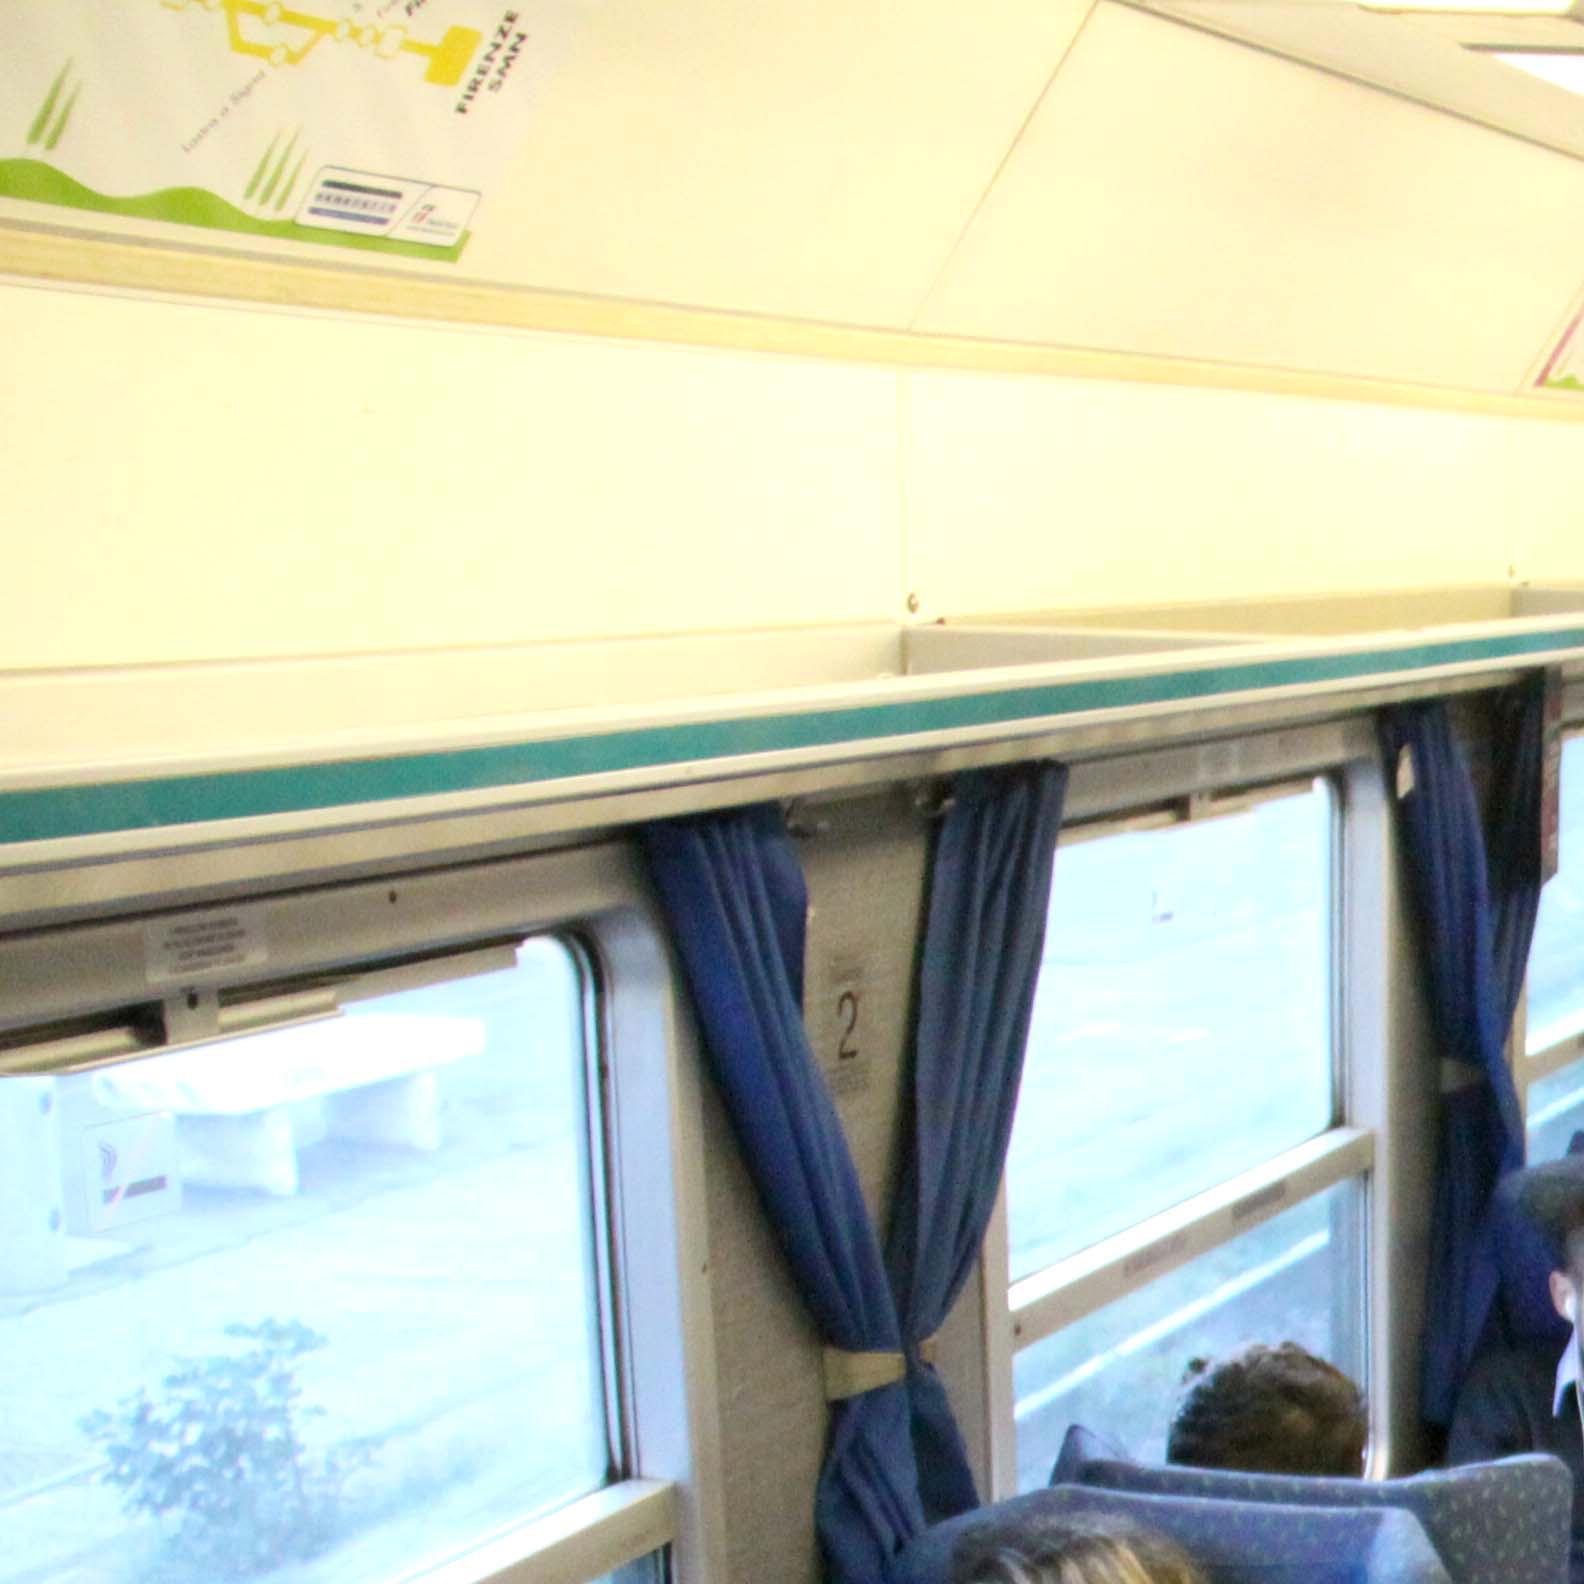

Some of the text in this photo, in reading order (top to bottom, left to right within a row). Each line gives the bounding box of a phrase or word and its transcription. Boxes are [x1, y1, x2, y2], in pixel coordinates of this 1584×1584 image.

[455, 9, 518, 115] FIRENZE
[487, 31, 528, 93] SMN
[836, 990, 858, 1060] 2
